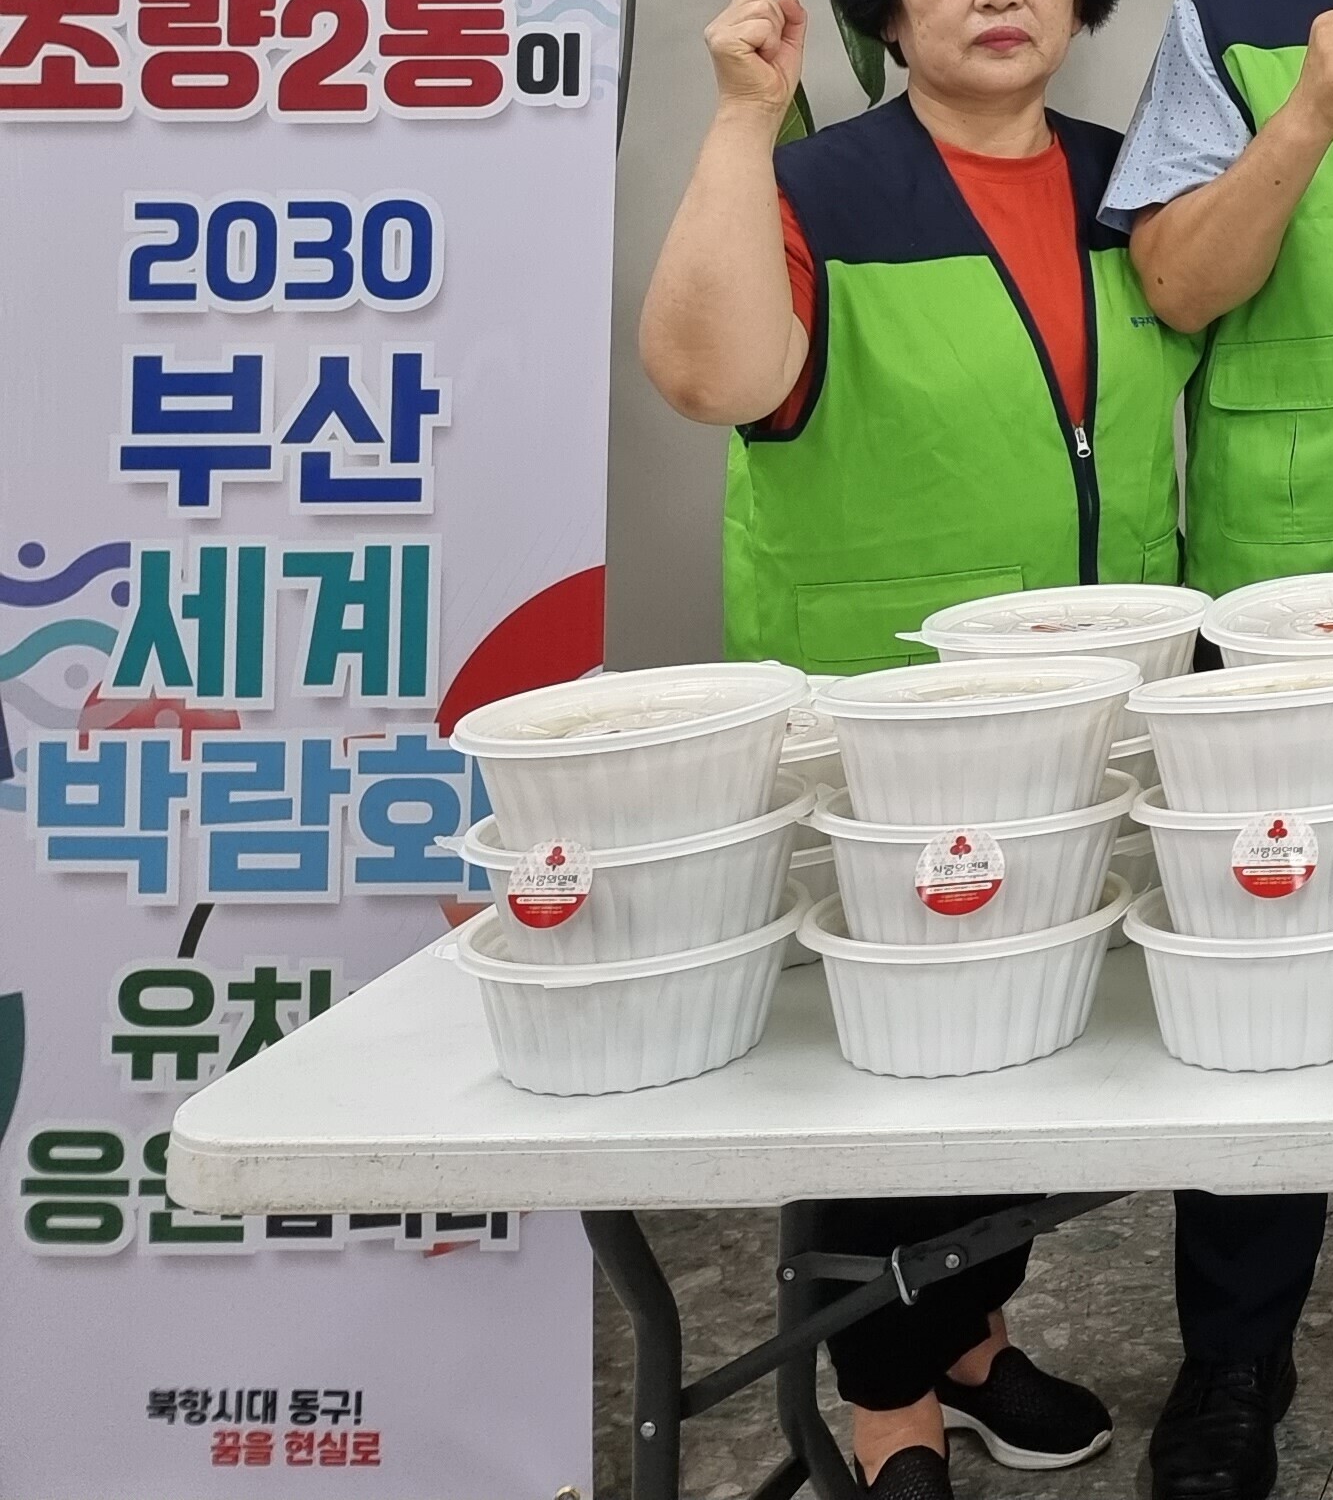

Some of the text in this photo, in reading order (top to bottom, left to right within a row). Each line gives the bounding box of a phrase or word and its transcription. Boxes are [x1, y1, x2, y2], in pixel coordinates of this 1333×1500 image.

[129, 200, 433, 301] 2030
[120, 352, 440, 507] 부산
[112, 544, 431, 698] 세계
[37, 734, 492, 895] 박람회
[111, 966, 354, 1082] 유치
[147, 1388, 364, 1426] 북항시대 동구!
[210, 1430, 381, 1467] 꿈을 현실로
